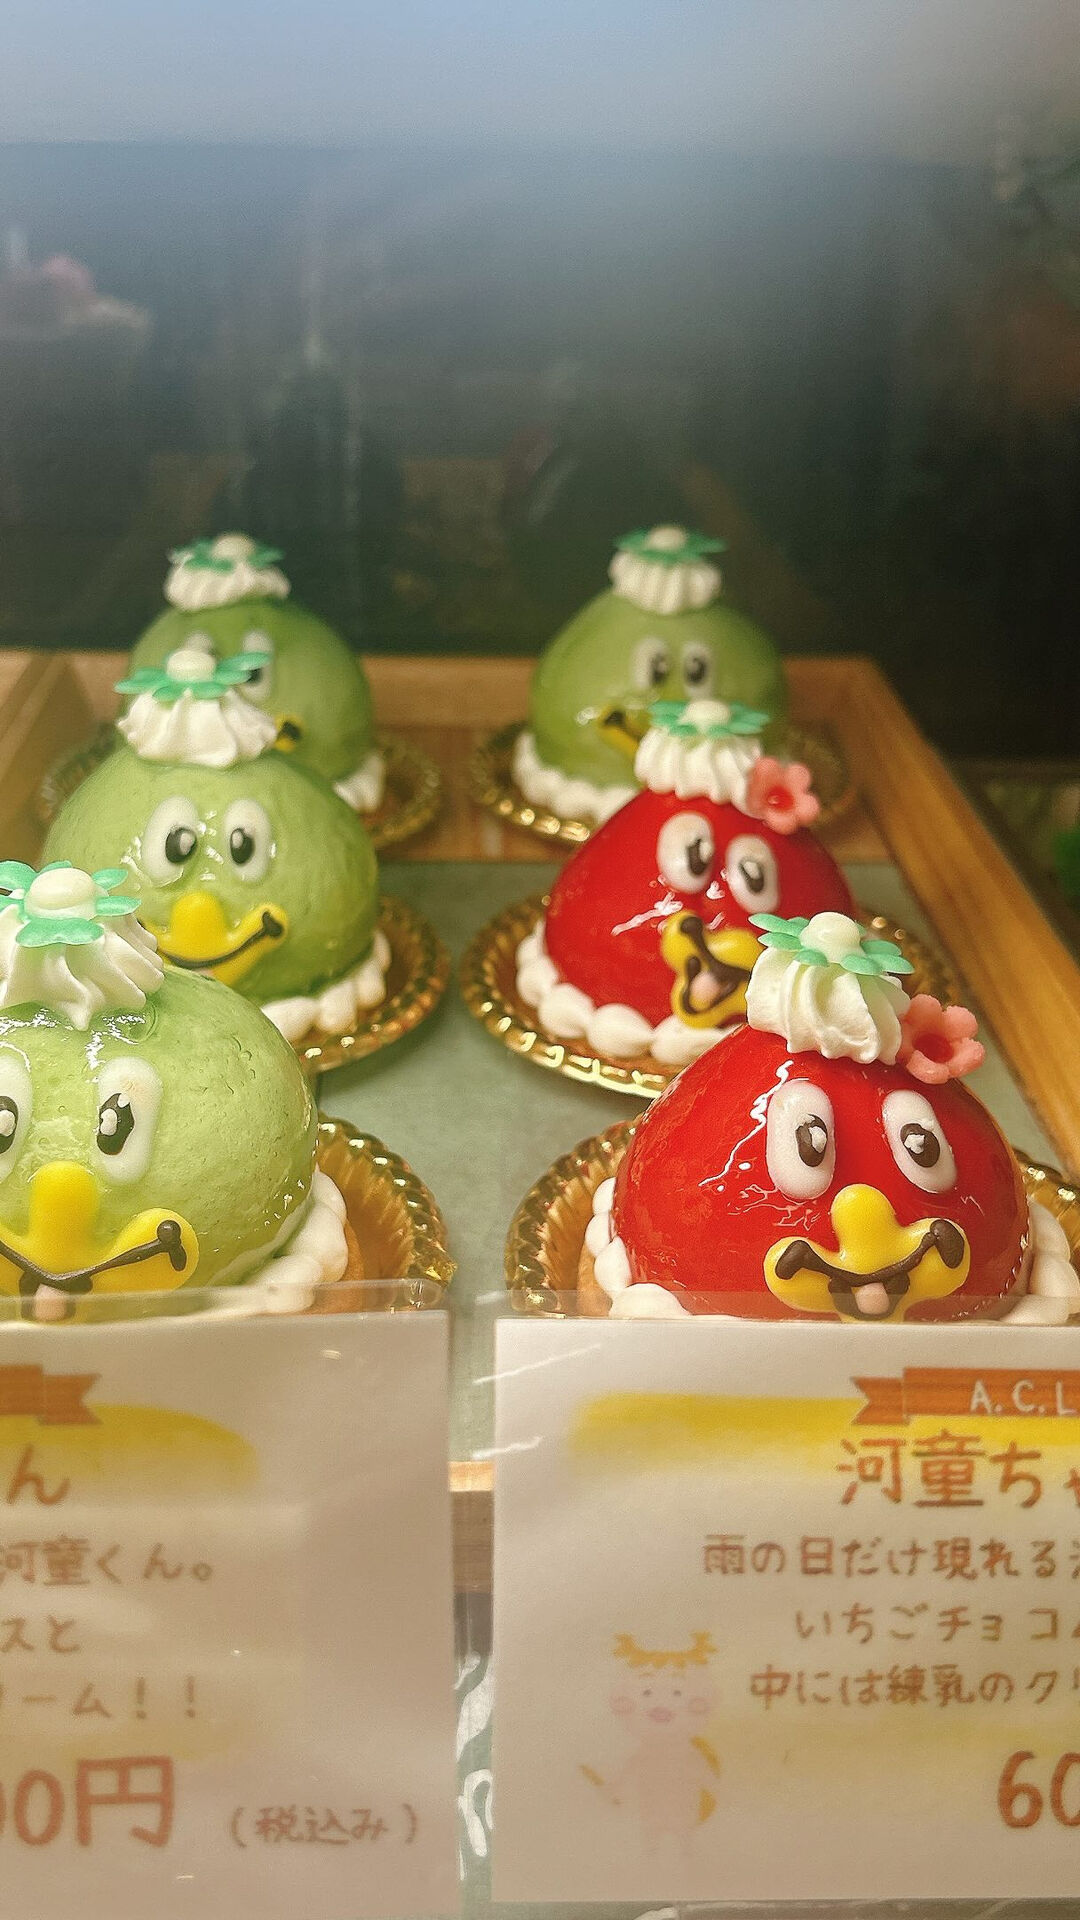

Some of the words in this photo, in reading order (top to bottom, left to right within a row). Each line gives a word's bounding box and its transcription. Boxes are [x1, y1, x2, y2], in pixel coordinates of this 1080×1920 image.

[7, 1443, 70, 1506] ん
[1, 1614, 80, 1653] スと
[795, 1603, 1080, 1643] いちごチョコ
[0, 1676, 196, 1719] ーム！！
[0, 1755, 174, 1847] 0円
